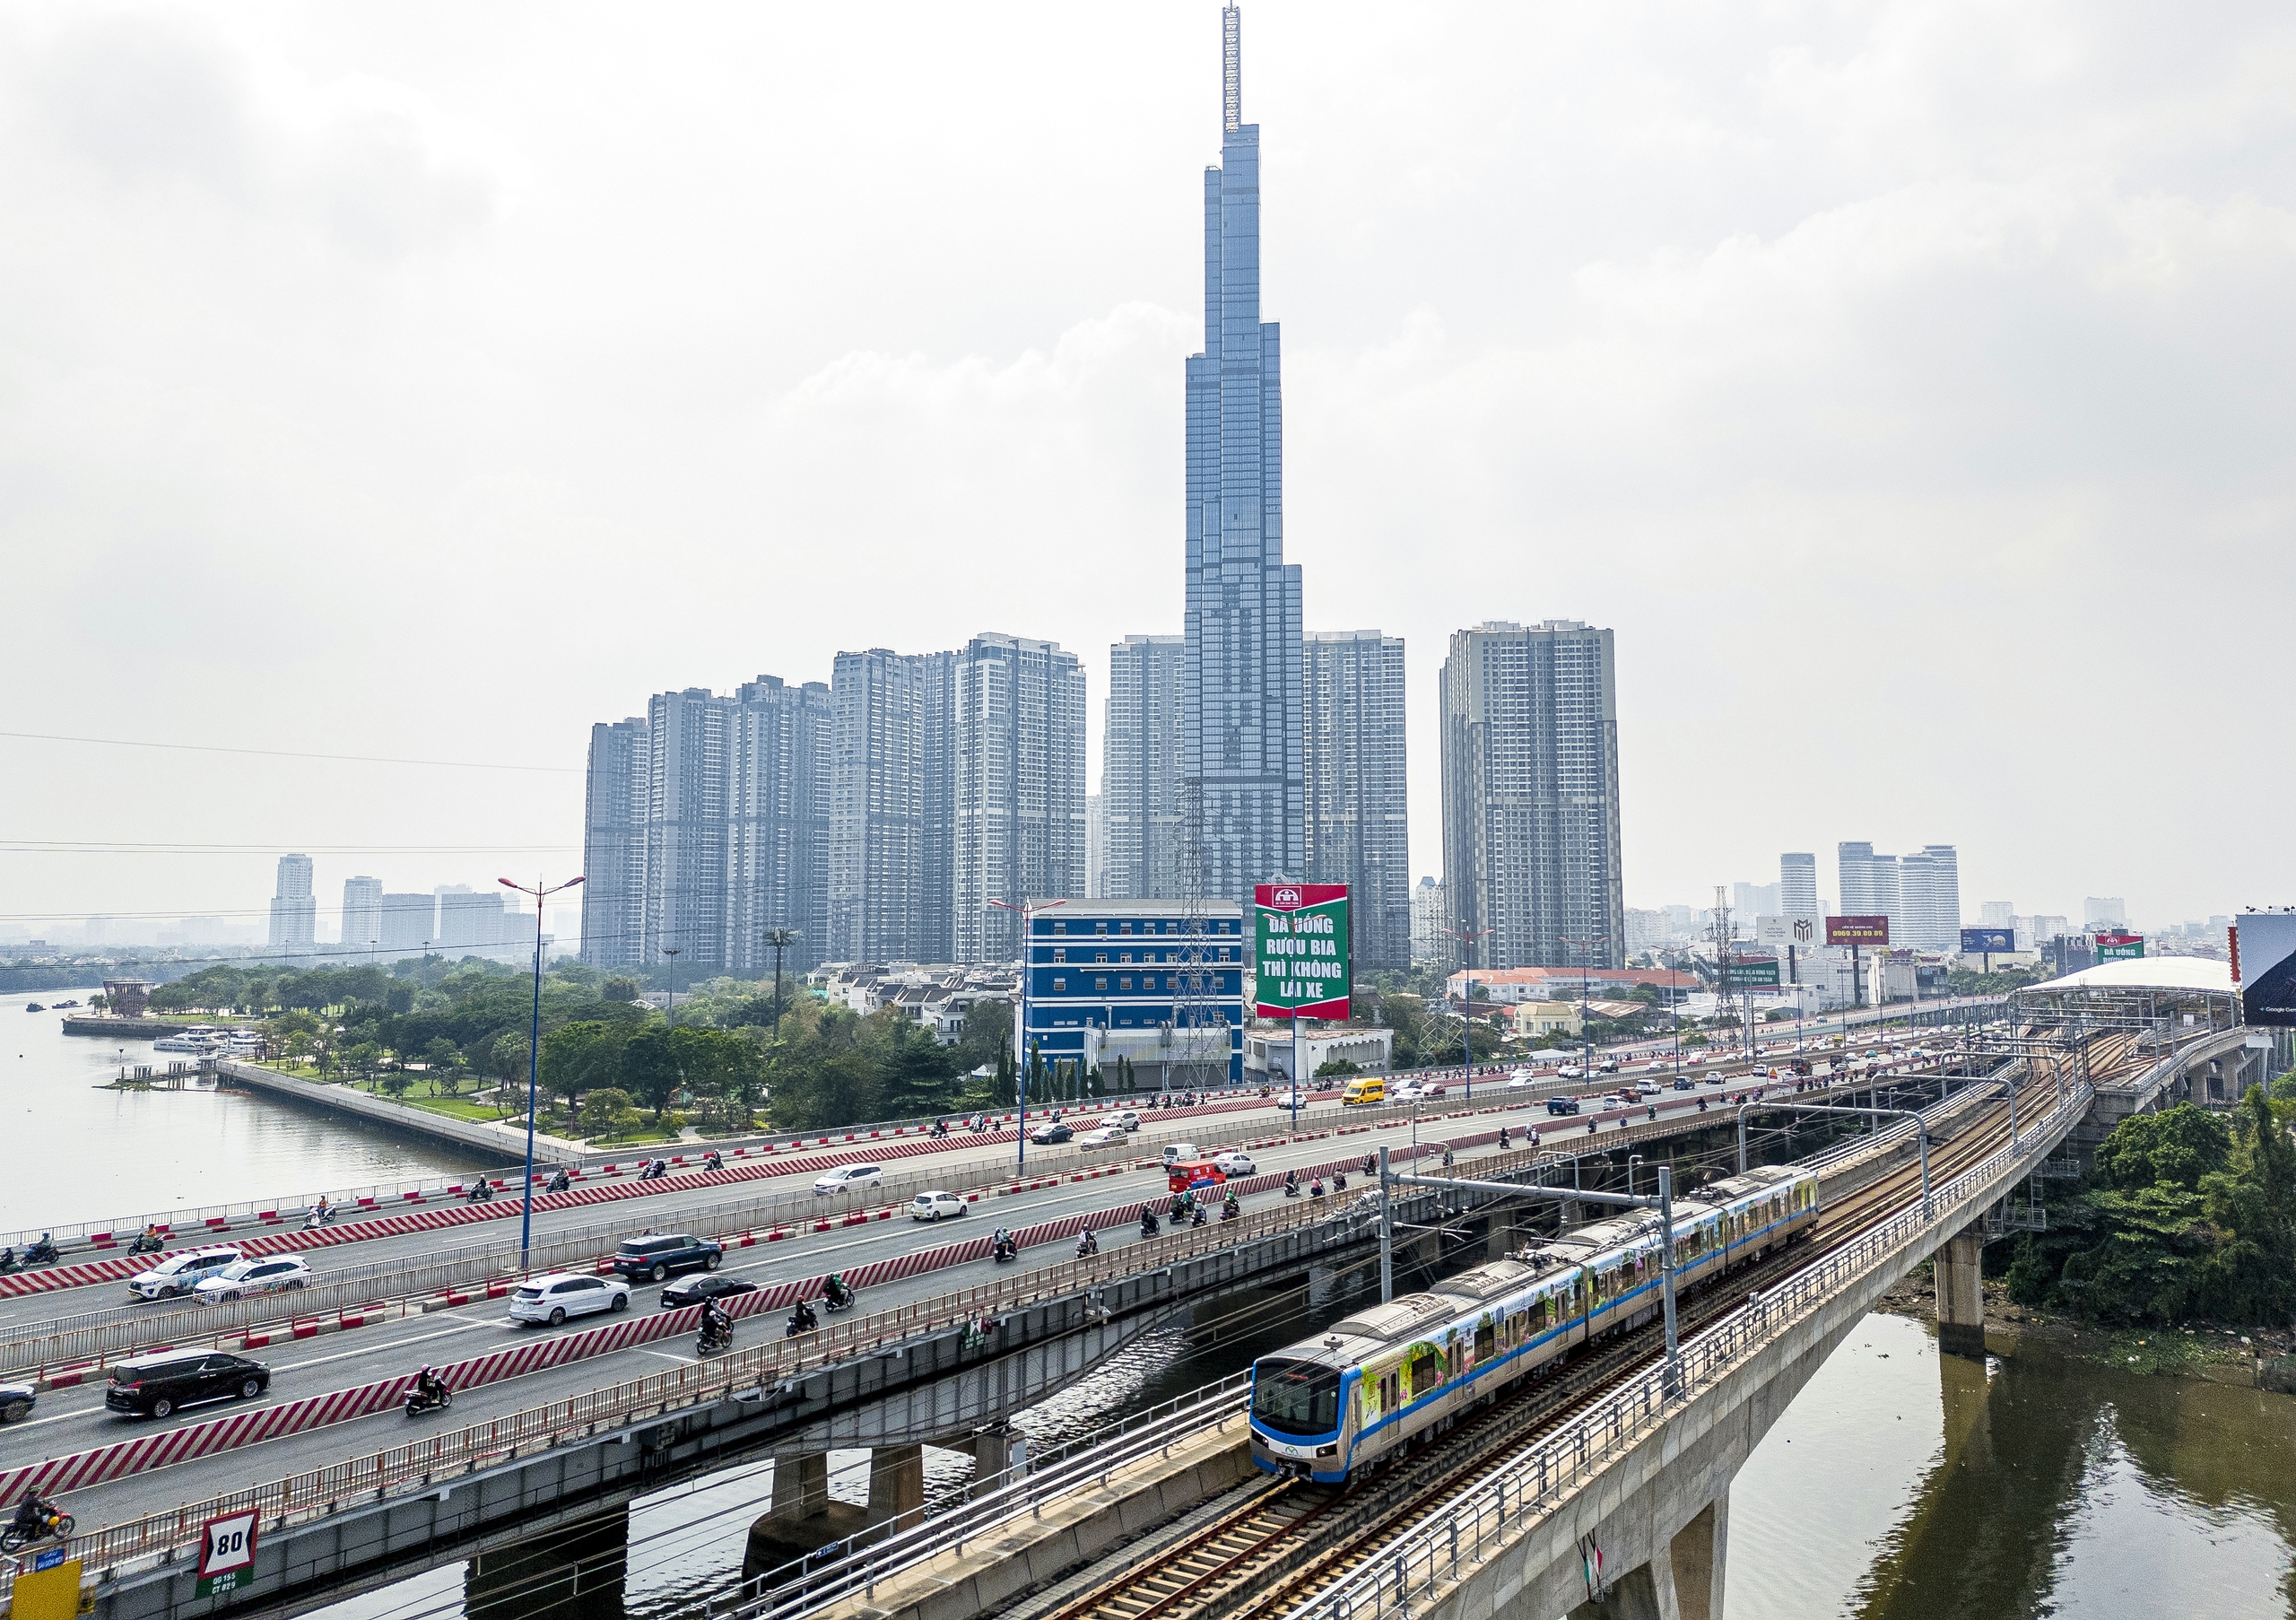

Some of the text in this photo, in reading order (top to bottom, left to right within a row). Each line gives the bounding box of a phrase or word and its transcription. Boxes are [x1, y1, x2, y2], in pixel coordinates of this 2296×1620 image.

[1266, 937, 1336, 957] RƯỢU BIA
[2115, 947, 2135, 956] UỐNG
[1263, 959, 1342, 979] THÌ KHÔNG
[1281, 980, 1324, 997] LÁI XE
[217, 1530, 242, 1556] 80
[223, 1572, 236, 1581] 155
[212, 1586, 221, 1594] CT
